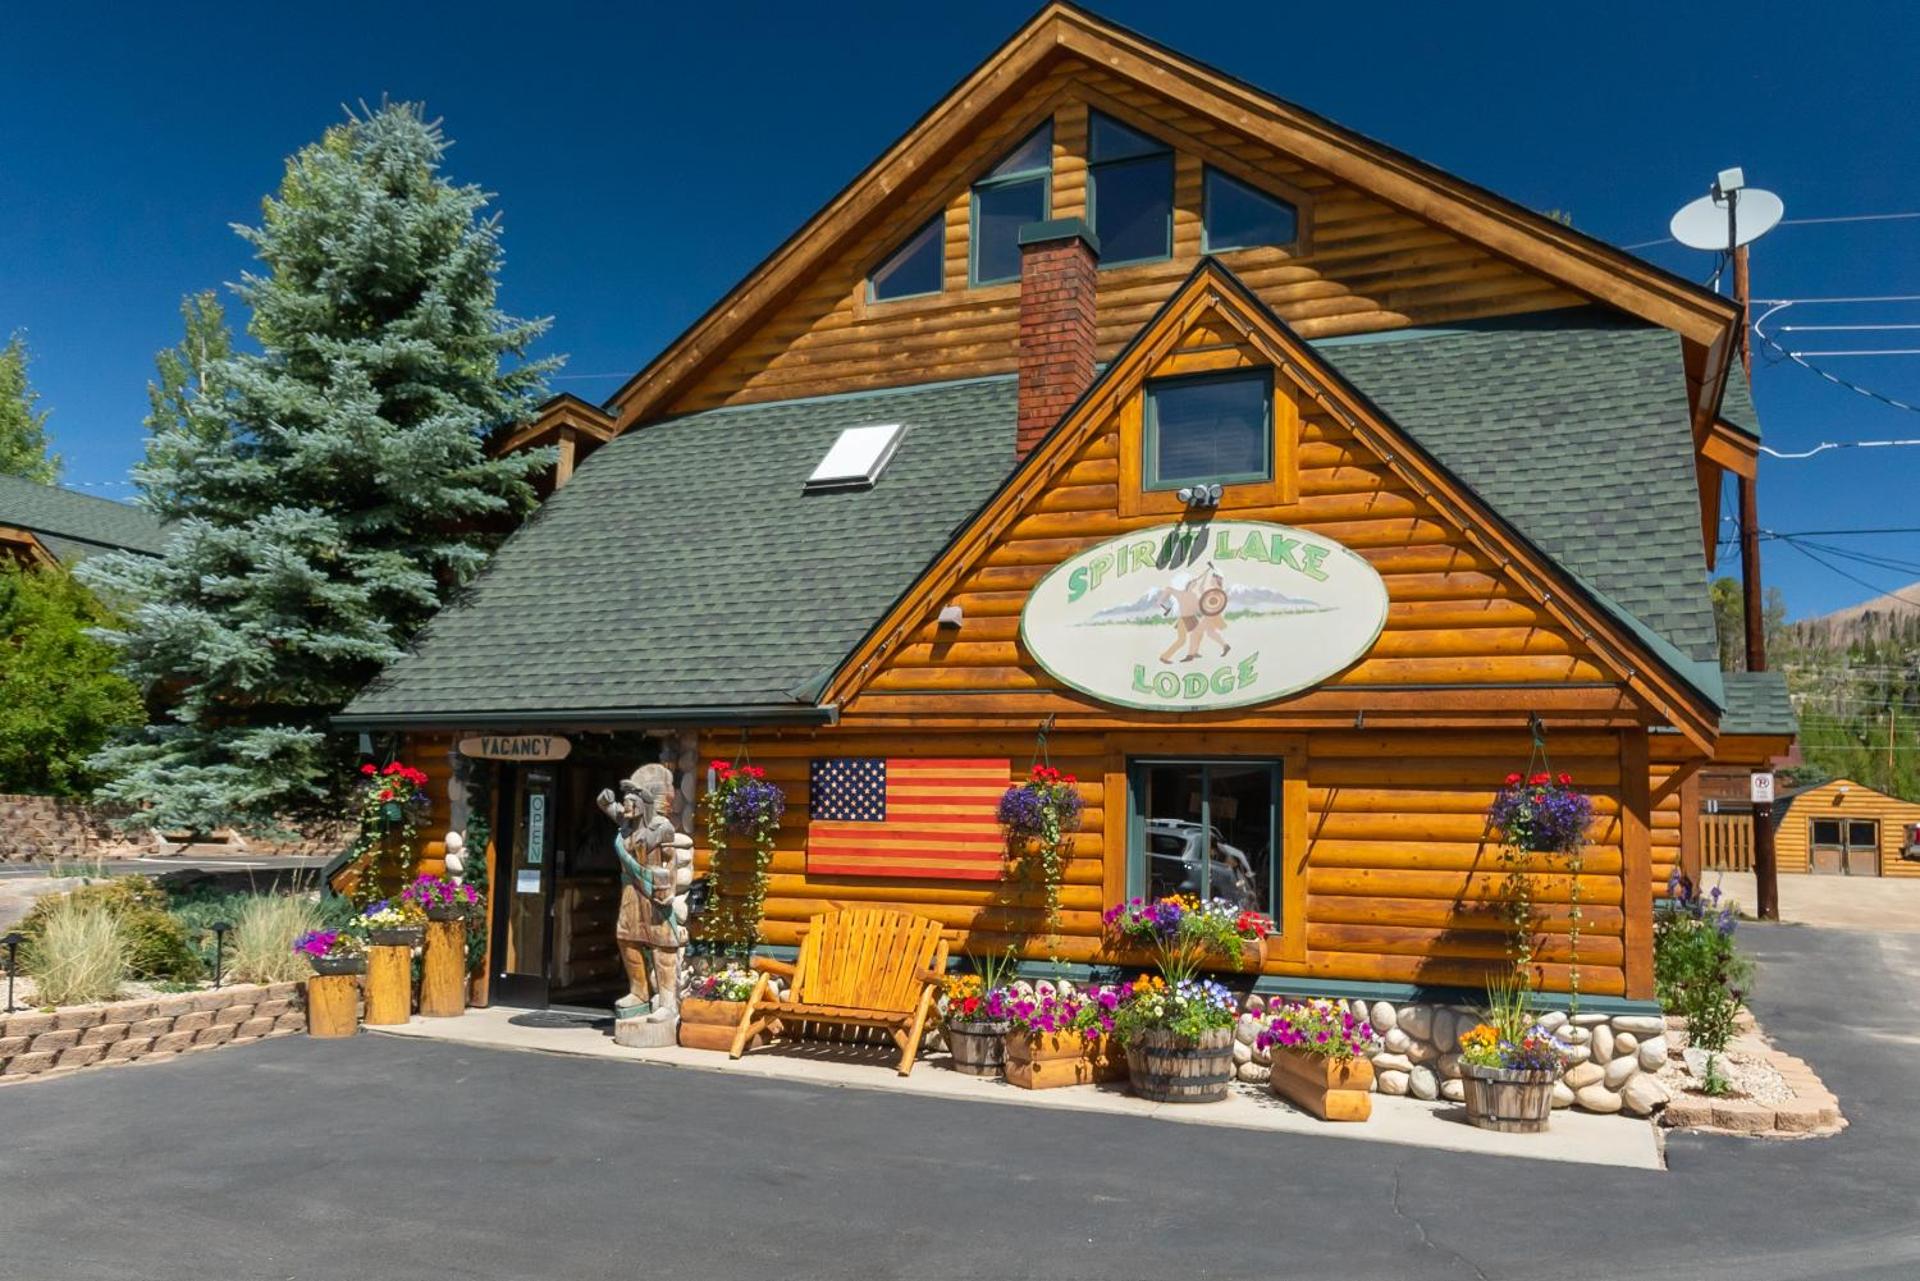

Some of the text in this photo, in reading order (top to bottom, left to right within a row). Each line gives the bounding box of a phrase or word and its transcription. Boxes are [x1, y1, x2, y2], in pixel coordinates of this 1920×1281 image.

[1068, 531, 1330, 603] SPIRIT LAKE
[1131, 650, 1259, 699] LODGE
[481, 738, 552, 756] VACANCY
[531, 797, 543, 860] OPEN
